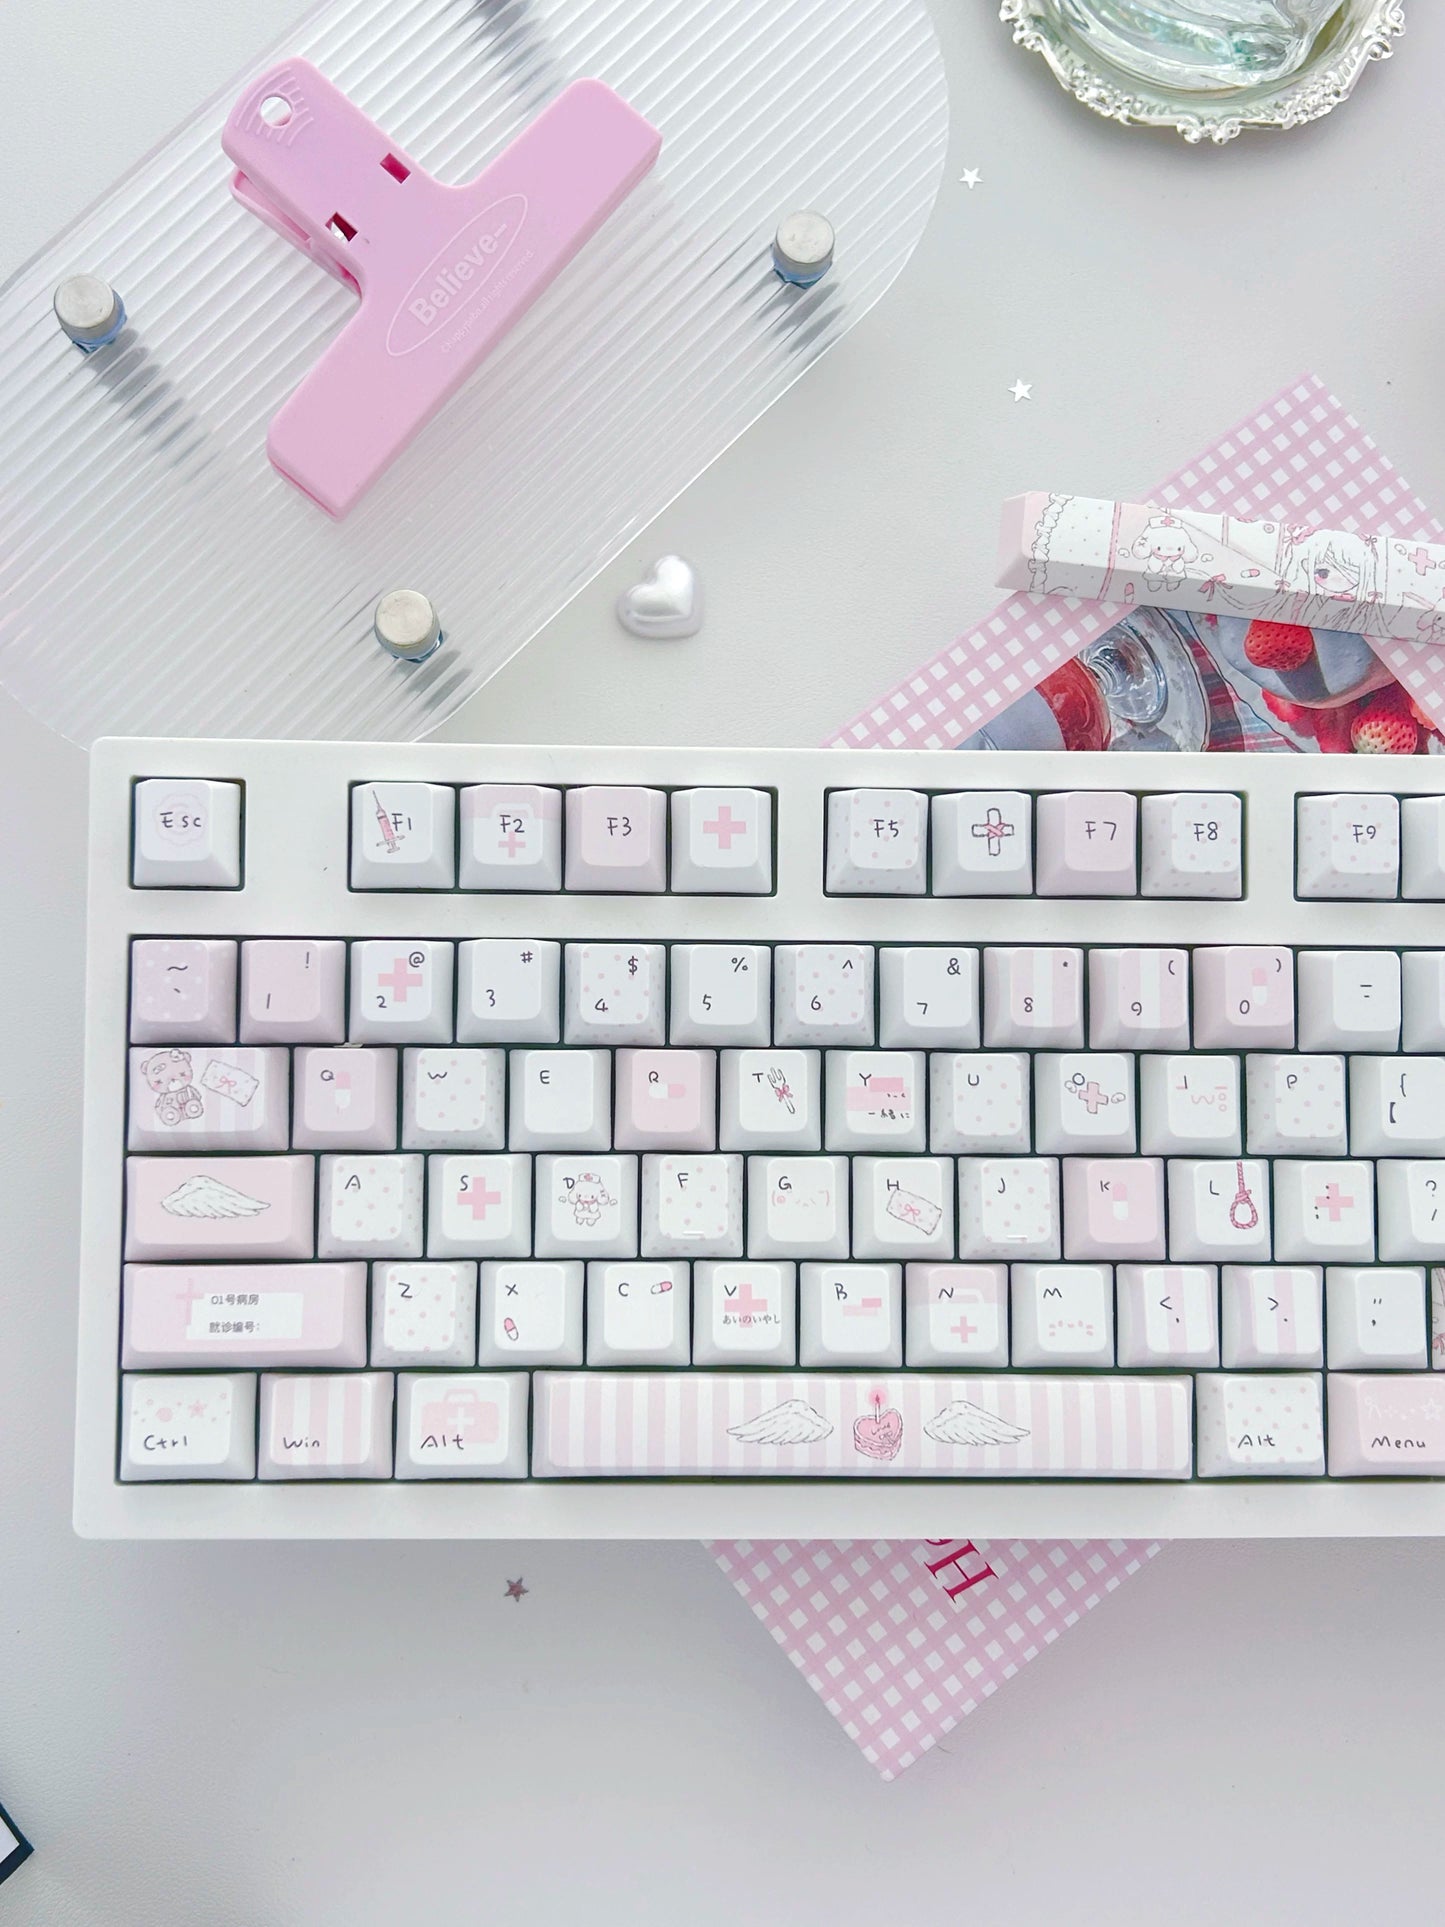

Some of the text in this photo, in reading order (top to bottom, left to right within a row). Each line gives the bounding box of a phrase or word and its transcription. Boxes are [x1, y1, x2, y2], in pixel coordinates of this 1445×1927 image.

[159, 811, 202, 829] Esc
[390, 812, 412, 832] F1
[499, 814, 525, 834] F2
[606, 816, 632, 837] F3
[873, 818, 899, 838] F5
[1084, 820, 1117, 841] F7
[1193, 821, 1219, 842] F8
[1352, 824, 1377, 843] F9
[408, 951, 425, 969] @
[519, 950, 533, 964] #
[731, 956, 749, 973] %
[627, 955, 639, 976] $
[946, 957, 961, 976] &
[376, 995, 387, 1009] 2
[485, 989, 496, 1007] 3
[594, 998, 609, 1013] 4
[702, 993, 712, 1011] 5
[810, 995, 822, 1011] 6
[1023, 996, 1034, 1013] 8
[916, 1002, 928, 1015] 7
[1130, 1001, 1143, 1017] 9
[320, 1069, 335, 1082] Q
[427, 1071, 448, 1080] W
[539, 1069, 550, 1085] E
[648, 1070, 659, 1084] R
[751, 1072, 764, 1083] T
[858, 1072, 872, 1087] Y
[967, 1073, 980, 1087] U
[1286, 1074, 1298, 1089] P
[344, 1174, 361, 1190] A
[459, 1174, 469, 1192] S
[562, 1176, 576, 1190] D
[677, 1172, 689, 1189] F
[778, 1175, 792, 1191] G
[886, 1178, 901, 1192] H
[997, 1177, 1006, 1194] J
[1099, 1180, 1111, 1193] K
[1209, 1180, 1220, 1196] L
[1425, 1179, 1437, 1197] ?
[397, 1282, 413, 1299] Z
[505, 1283, 519, 1297] X
[618, 1282, 630, 1297] C
[723, 1284, 737, 1297] V
[834, 1282, 848, 1301] B
[938, 1287, 954, 1299] N
[1042, 1287, 1063, 1299] M
[1159, 1296, 1173, 1310] <
[1267, 1297, 1279, 1311] >
[143, 1434, 188, 1451] Ctrl
[283, 1437, 320, 1450] Win
[420, 1434, 464, 1451] Alt
[1237, 1434, 1276, 1449] Alt
[1371, 1435, 1426, 1449] Menu
